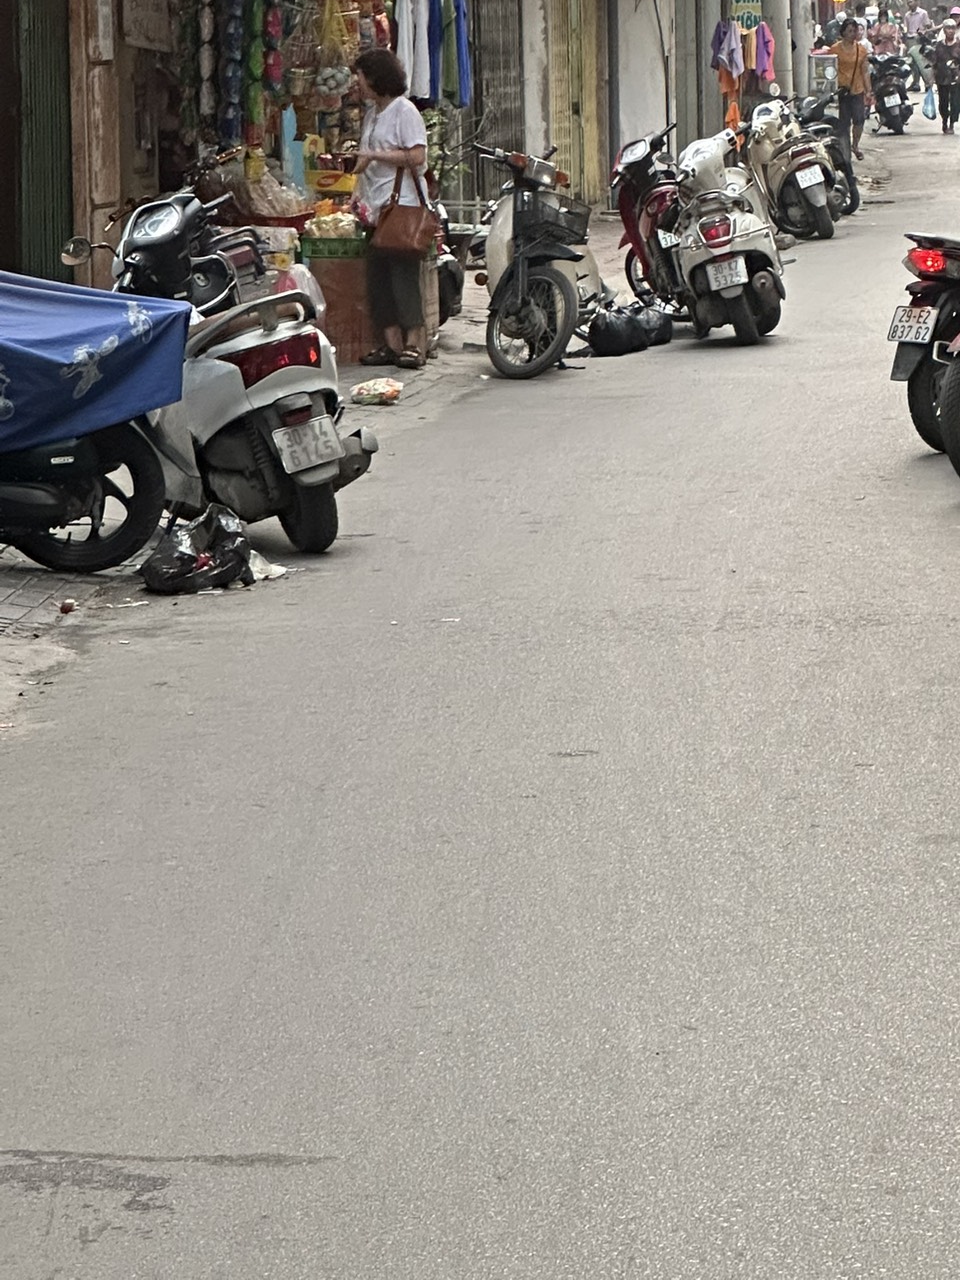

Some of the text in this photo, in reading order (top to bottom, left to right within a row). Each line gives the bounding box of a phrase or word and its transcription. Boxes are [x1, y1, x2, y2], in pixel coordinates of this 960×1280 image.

[711, 260, 738, 276] 30-K7
[898, 309, 932, 324] 29-E2
[891, 324, 930, 341] 837.62
